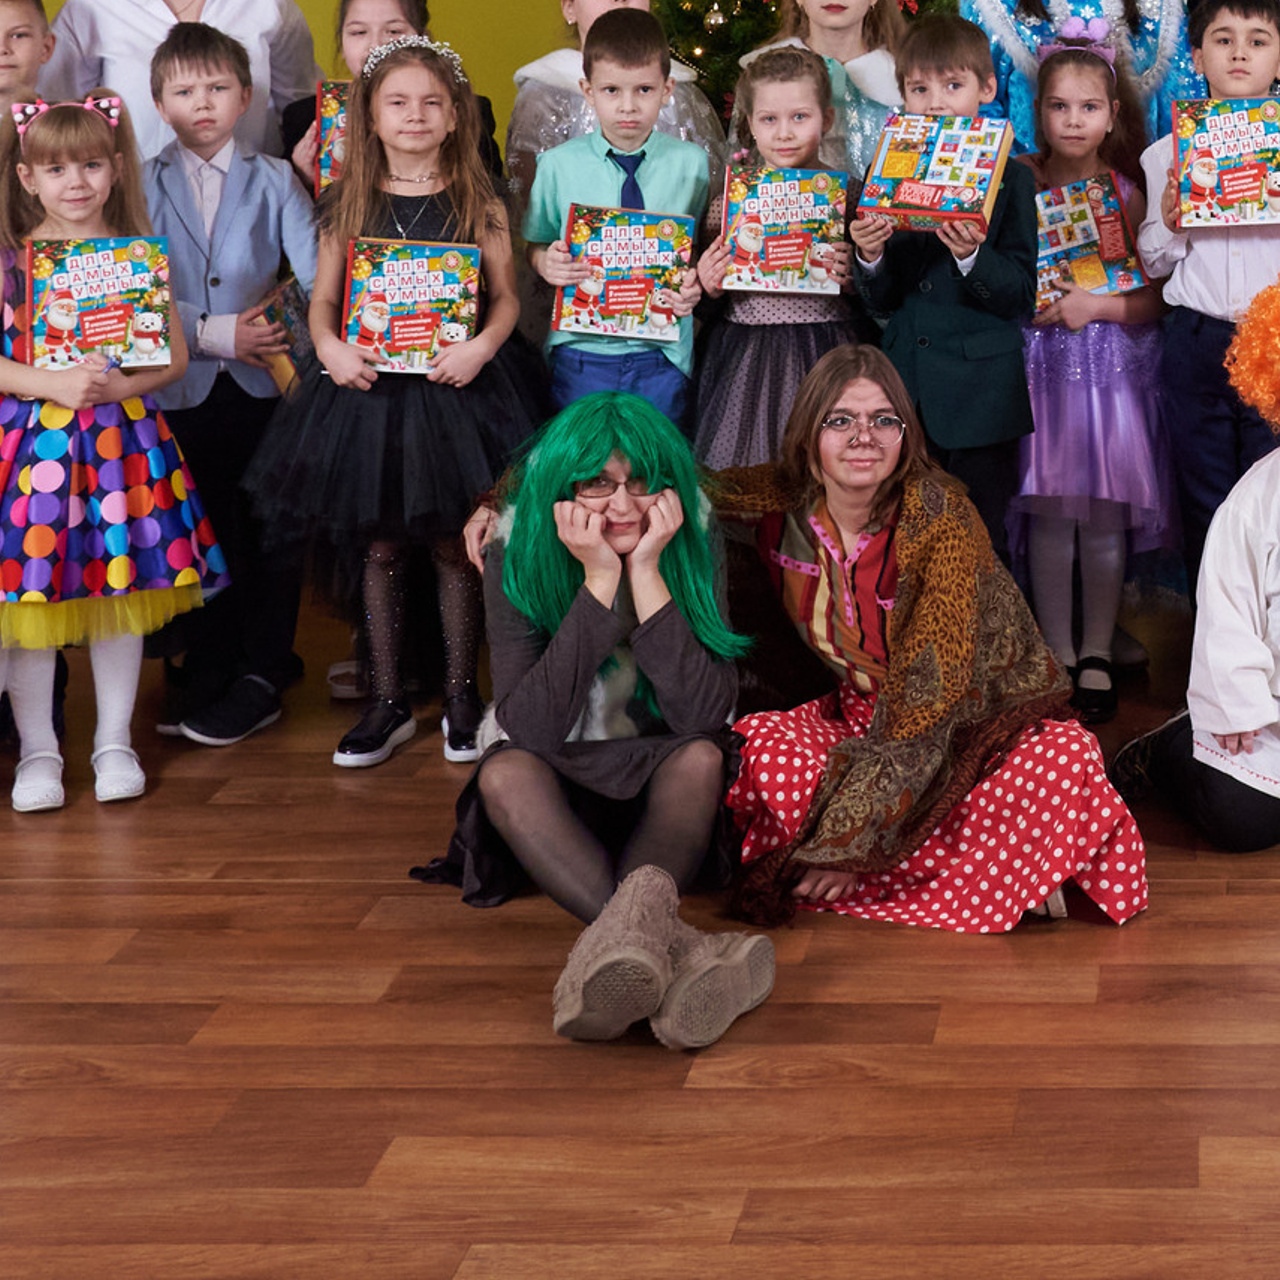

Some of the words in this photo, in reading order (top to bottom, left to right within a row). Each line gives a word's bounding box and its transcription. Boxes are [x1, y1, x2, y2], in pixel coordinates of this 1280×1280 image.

[1209, 112, 1246, 128] ДЛЯ
[1197, 124, 1261, 145] САМЫХ
[1214, 135, 1278, 155] УМНЫХ
[761, 182, 797, 195] ДЛЯ
[747, 195, 811, 210] САМЫХ
[763, 207, 826, 222] УМНЫХ
[604, 227, 641, 239] ДЛЯ
[590, 241, 656, 252] САМЫХ
[69, 252, 110, 269] ДЛЯ
[386, 261, 425, 273] ДЛЯ
[605, 253, 670, 266] УМНЫХ
[56, 265, 128, 285] САМЫХ
[372, 274, 440, 288] САМЫХ
[75, 276, 147, 296] УМНЫХ
[389, 286, 456, 300] УМНЫХ
